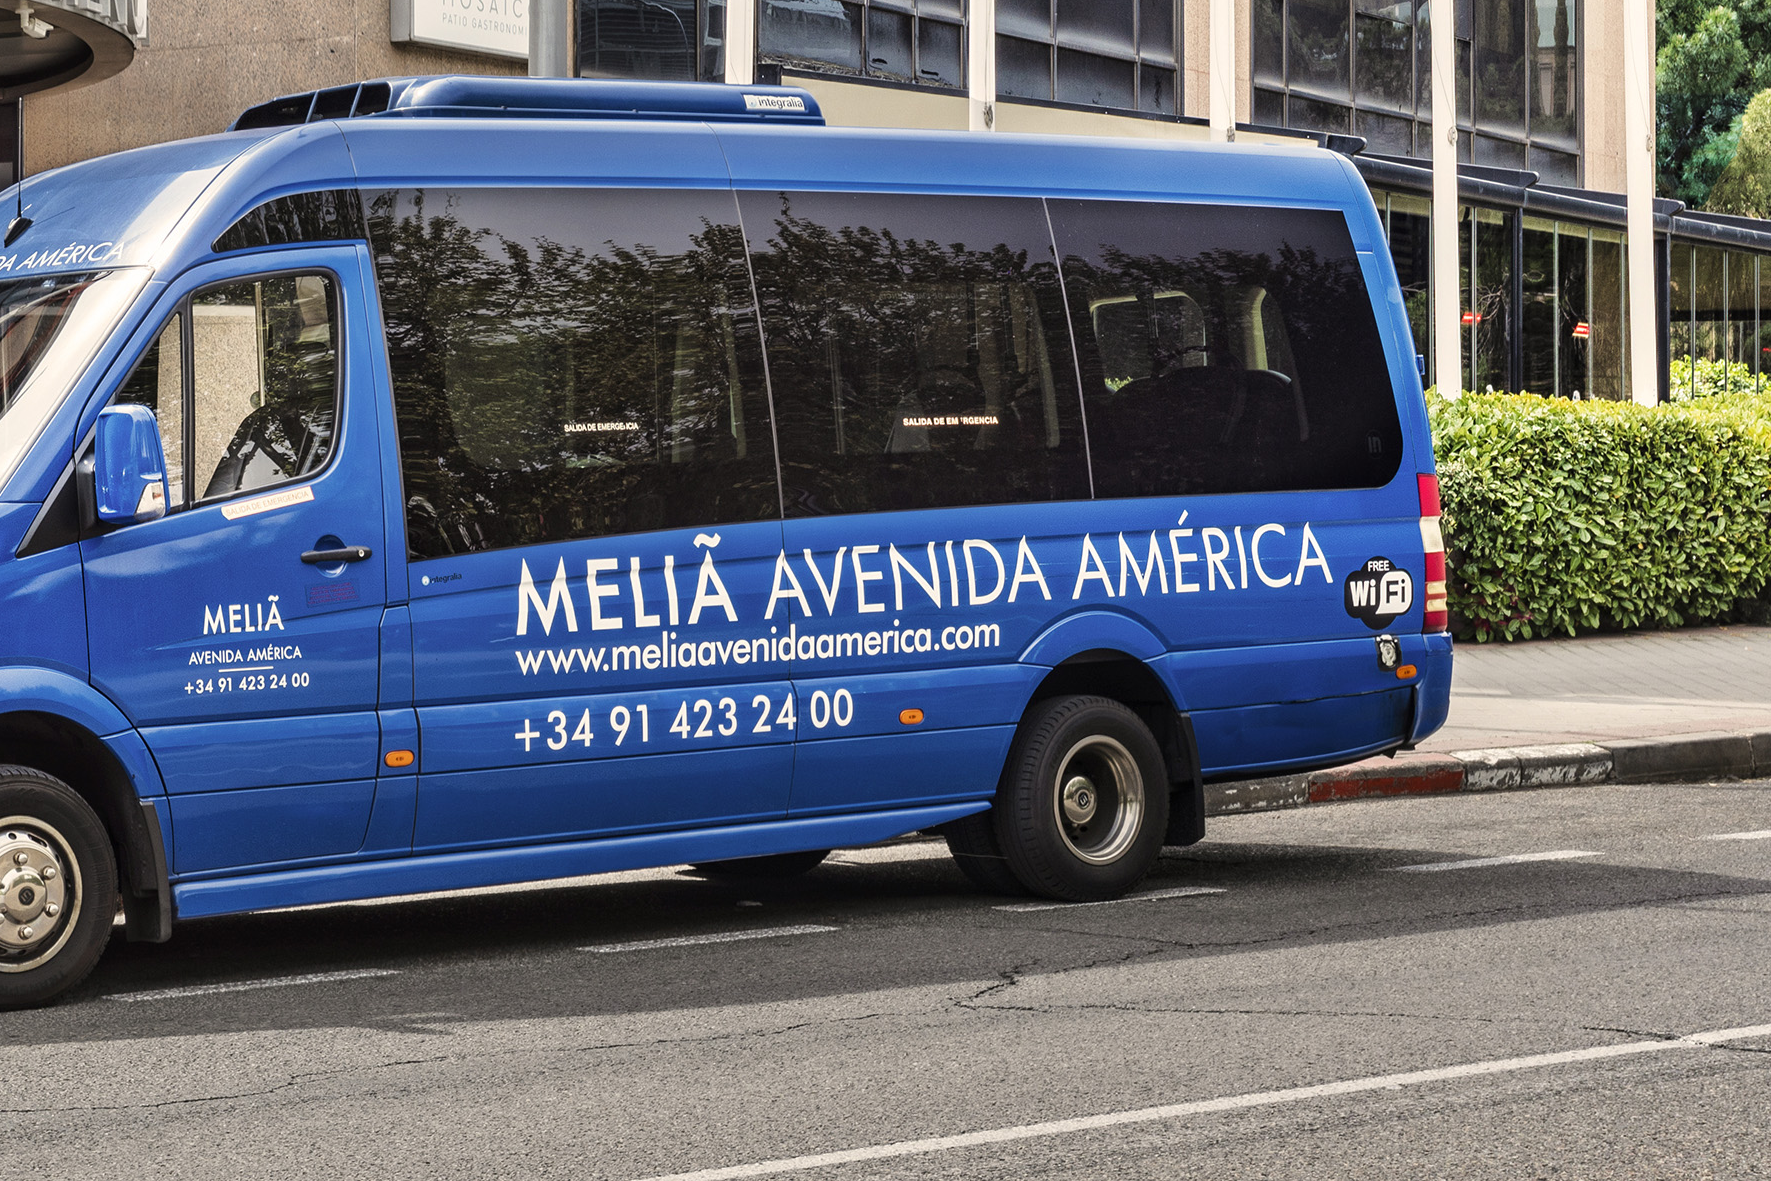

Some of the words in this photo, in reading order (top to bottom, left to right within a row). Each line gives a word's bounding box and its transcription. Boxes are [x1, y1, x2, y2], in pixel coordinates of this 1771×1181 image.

[442, 12, 468, 27] PATIO
[758, 97, 804, 109] integralia
[20, 241, 125, 269] AMÉRICA
[564, 423, 587, 432] SALIDA
[587, 422, 597, 431] DE
[903, 417, 932, 426] SALIDA
[933, 417, 945, 425] DE
[946, 416, 999, 425] EMRGENCIA
[225, 504, 251, 516] SALIDA
[251, 502, 262, 511] DE
[262, 490, 309, 509] EMERGENCIA
[516, 532, 739, 637] MELIÃ
[764, 535, 1053, 620] AVENIDA
[1072, 509, 1334, 599] AMÉRICA
[1367, 560, 1390, 572] FREE
[203, 595, 285, 635] MELIÃ
[188, 647, 244, 666] AVENIDA
[247, 644, 302, 662] AMÉRICA
[515, 619, 1001, 676] www.meliaavenidaamerica.com
[184, 678, 214, 695] +34
[218, 677, 232, 693] 91
[238, 675, 265, 691] 423
[269, 674, 288, 689] 24
[291, 672, 310, 687] 00
[514, 707, 595, 752] +34
[609, 704, 649, 746] 91
[669, 697, 738, 739] 423
[752, 692, 797, 733] 24
[809, 688, 854, 729] 00
